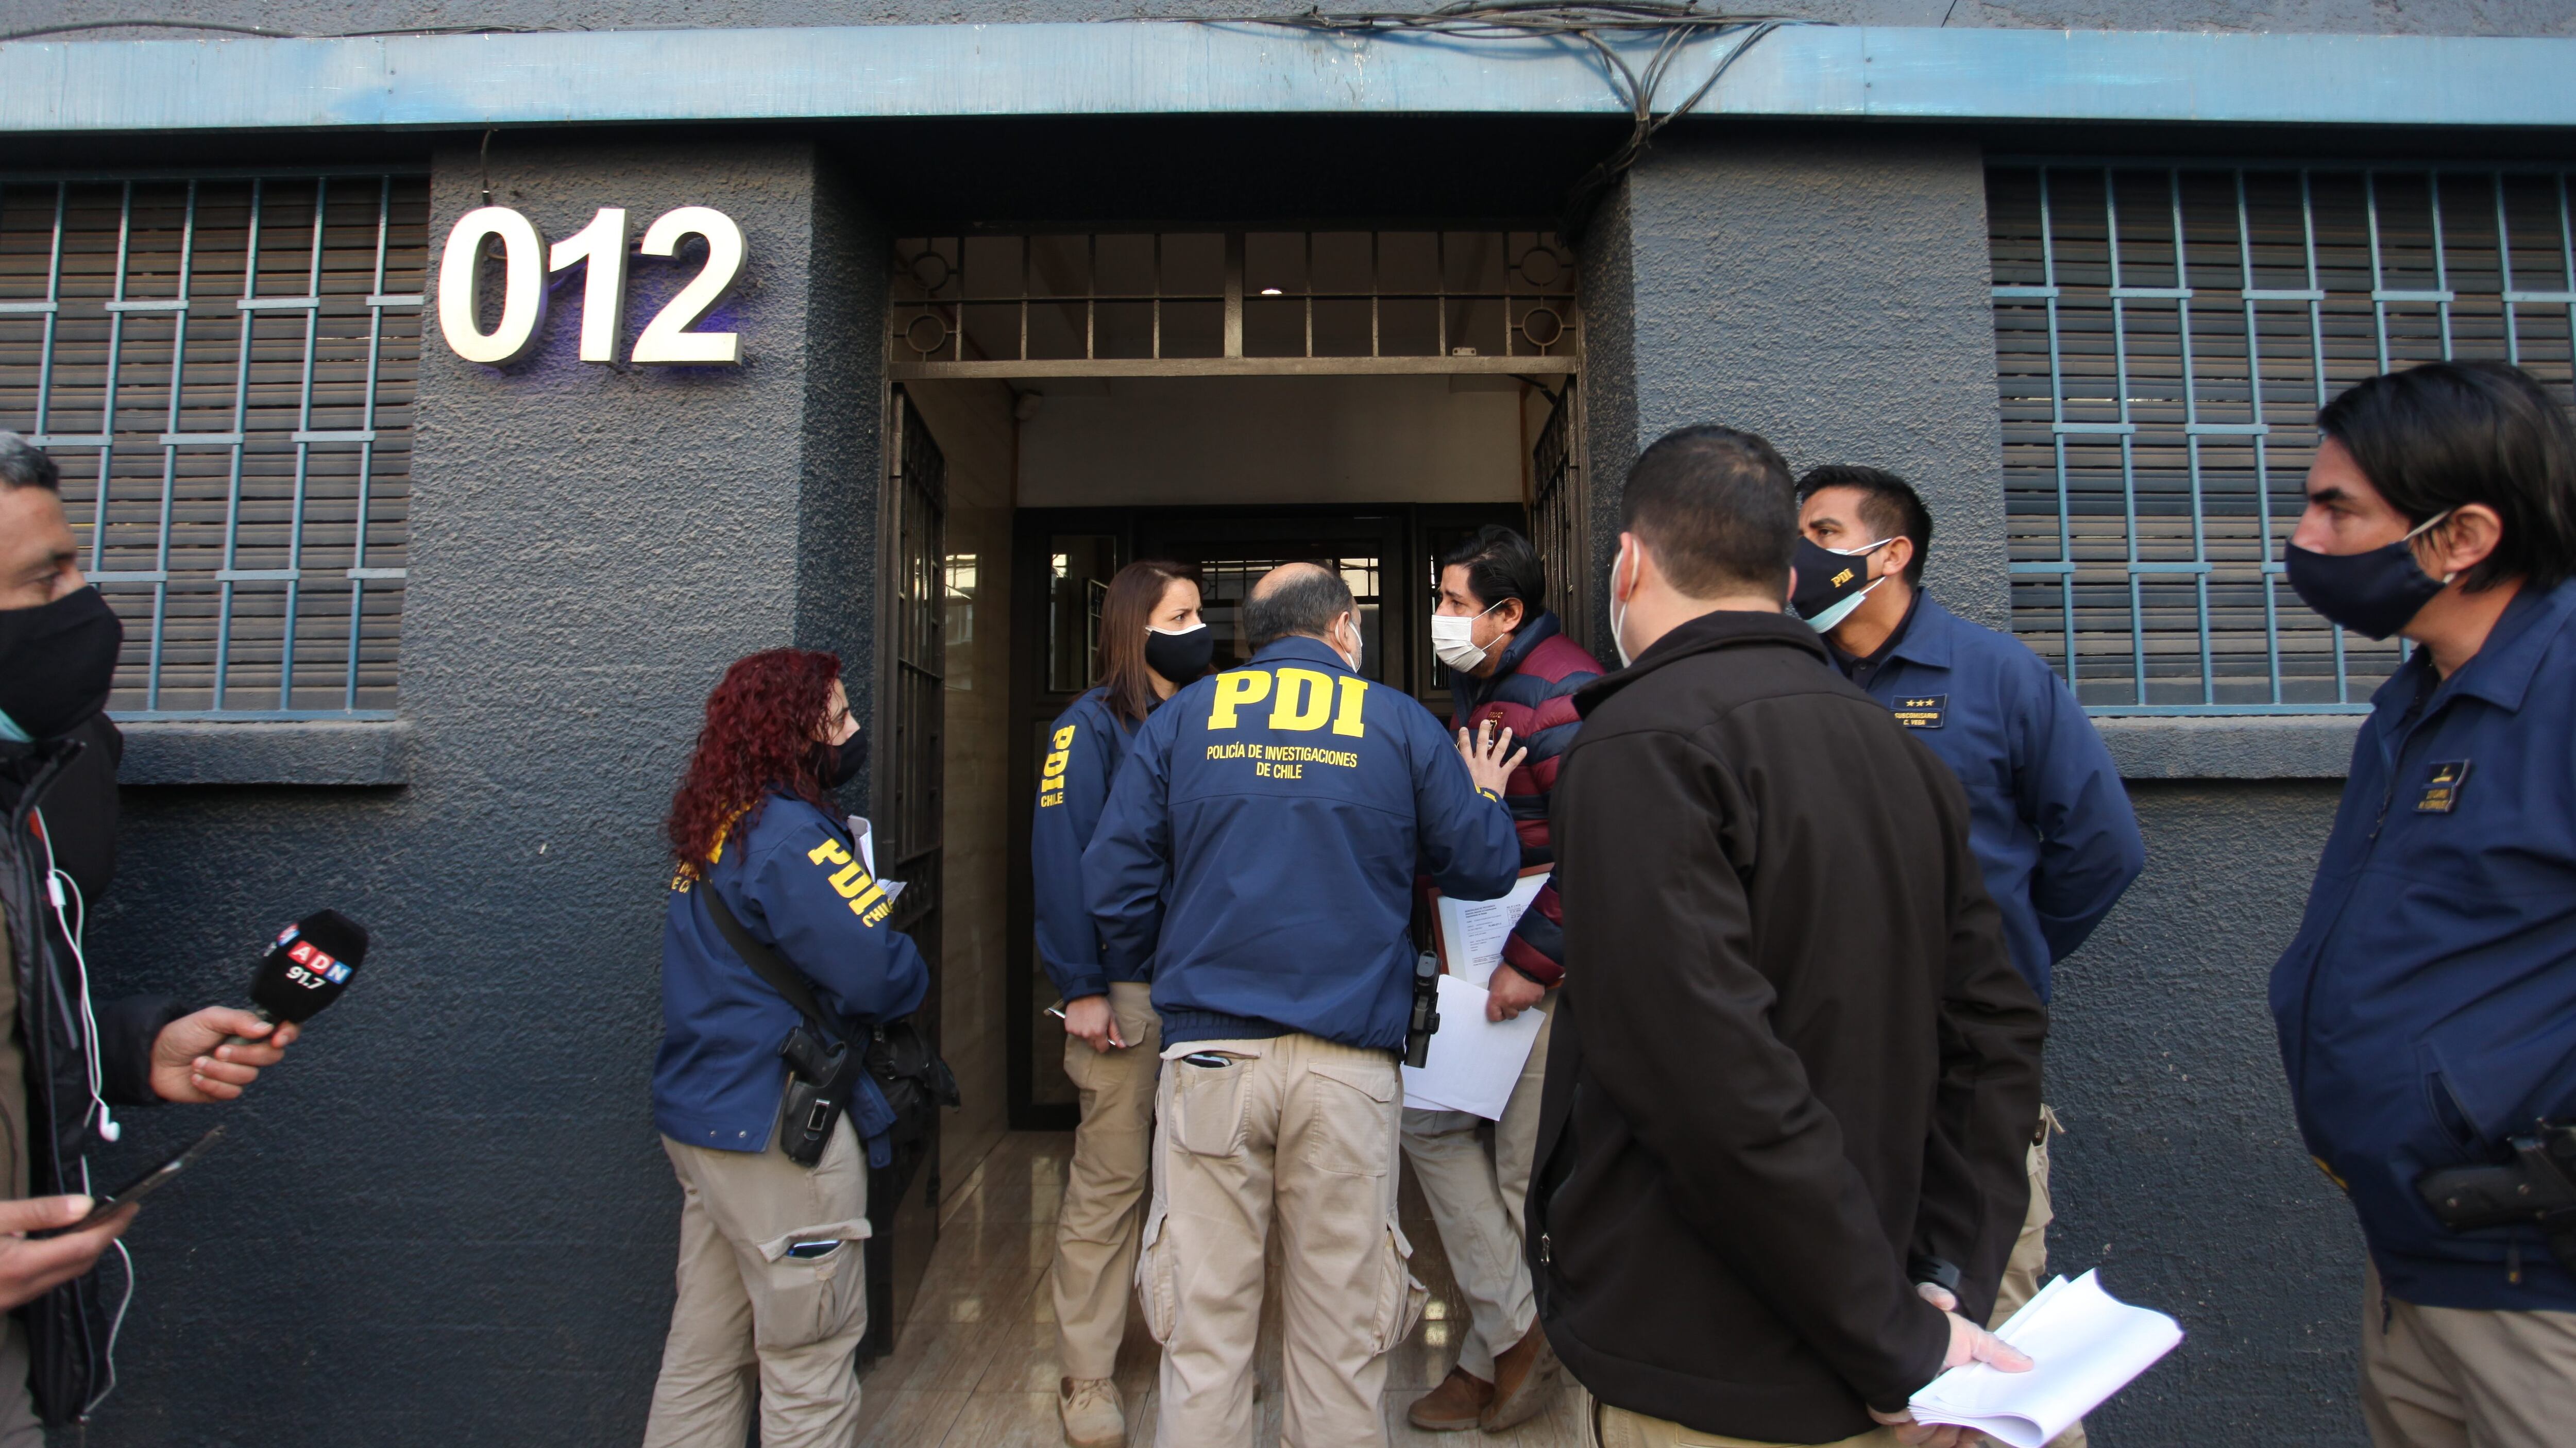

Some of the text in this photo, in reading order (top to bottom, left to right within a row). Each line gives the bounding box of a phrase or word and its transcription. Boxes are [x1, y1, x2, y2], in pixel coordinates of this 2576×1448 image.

[438, 206, 746, 364] 012
[1831, 568, 1854, 588] PDI
[1207, 668, 1368, 738] PDI
[1041, 725, 1076, 793] PDI
[1207, 742, 1358, 768] POLICÍA DE INVESTIGACIONES
[1256, 762, 1302, 779] DE CHILE
[1041, 792, 1064, 807] CHILE
[807, 838, 886, 915] PDI
[285, 966, 326, 989] 91.7
[291, 946, 348, 981] ADN
